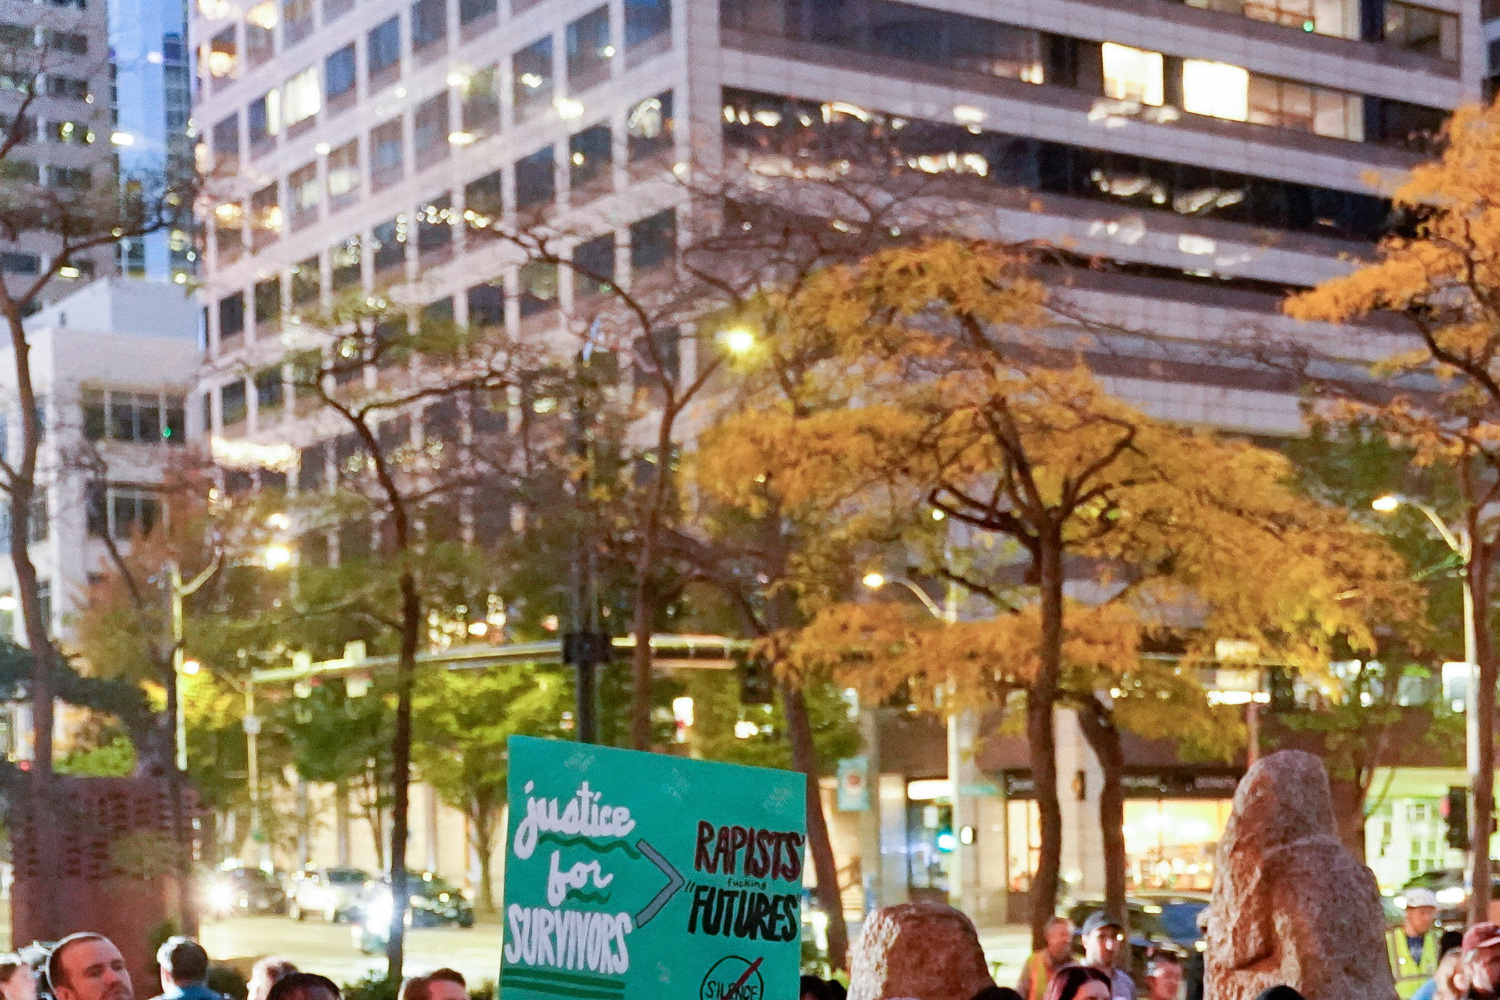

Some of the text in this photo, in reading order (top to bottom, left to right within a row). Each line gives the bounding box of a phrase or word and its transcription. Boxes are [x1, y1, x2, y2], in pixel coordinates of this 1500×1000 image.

[513, 780, 636, 860] justice
[547, 850, 614, 907] for
[727, 877, 768, 892] fucking
[504, 903, 633, 975] SURVIVORS
